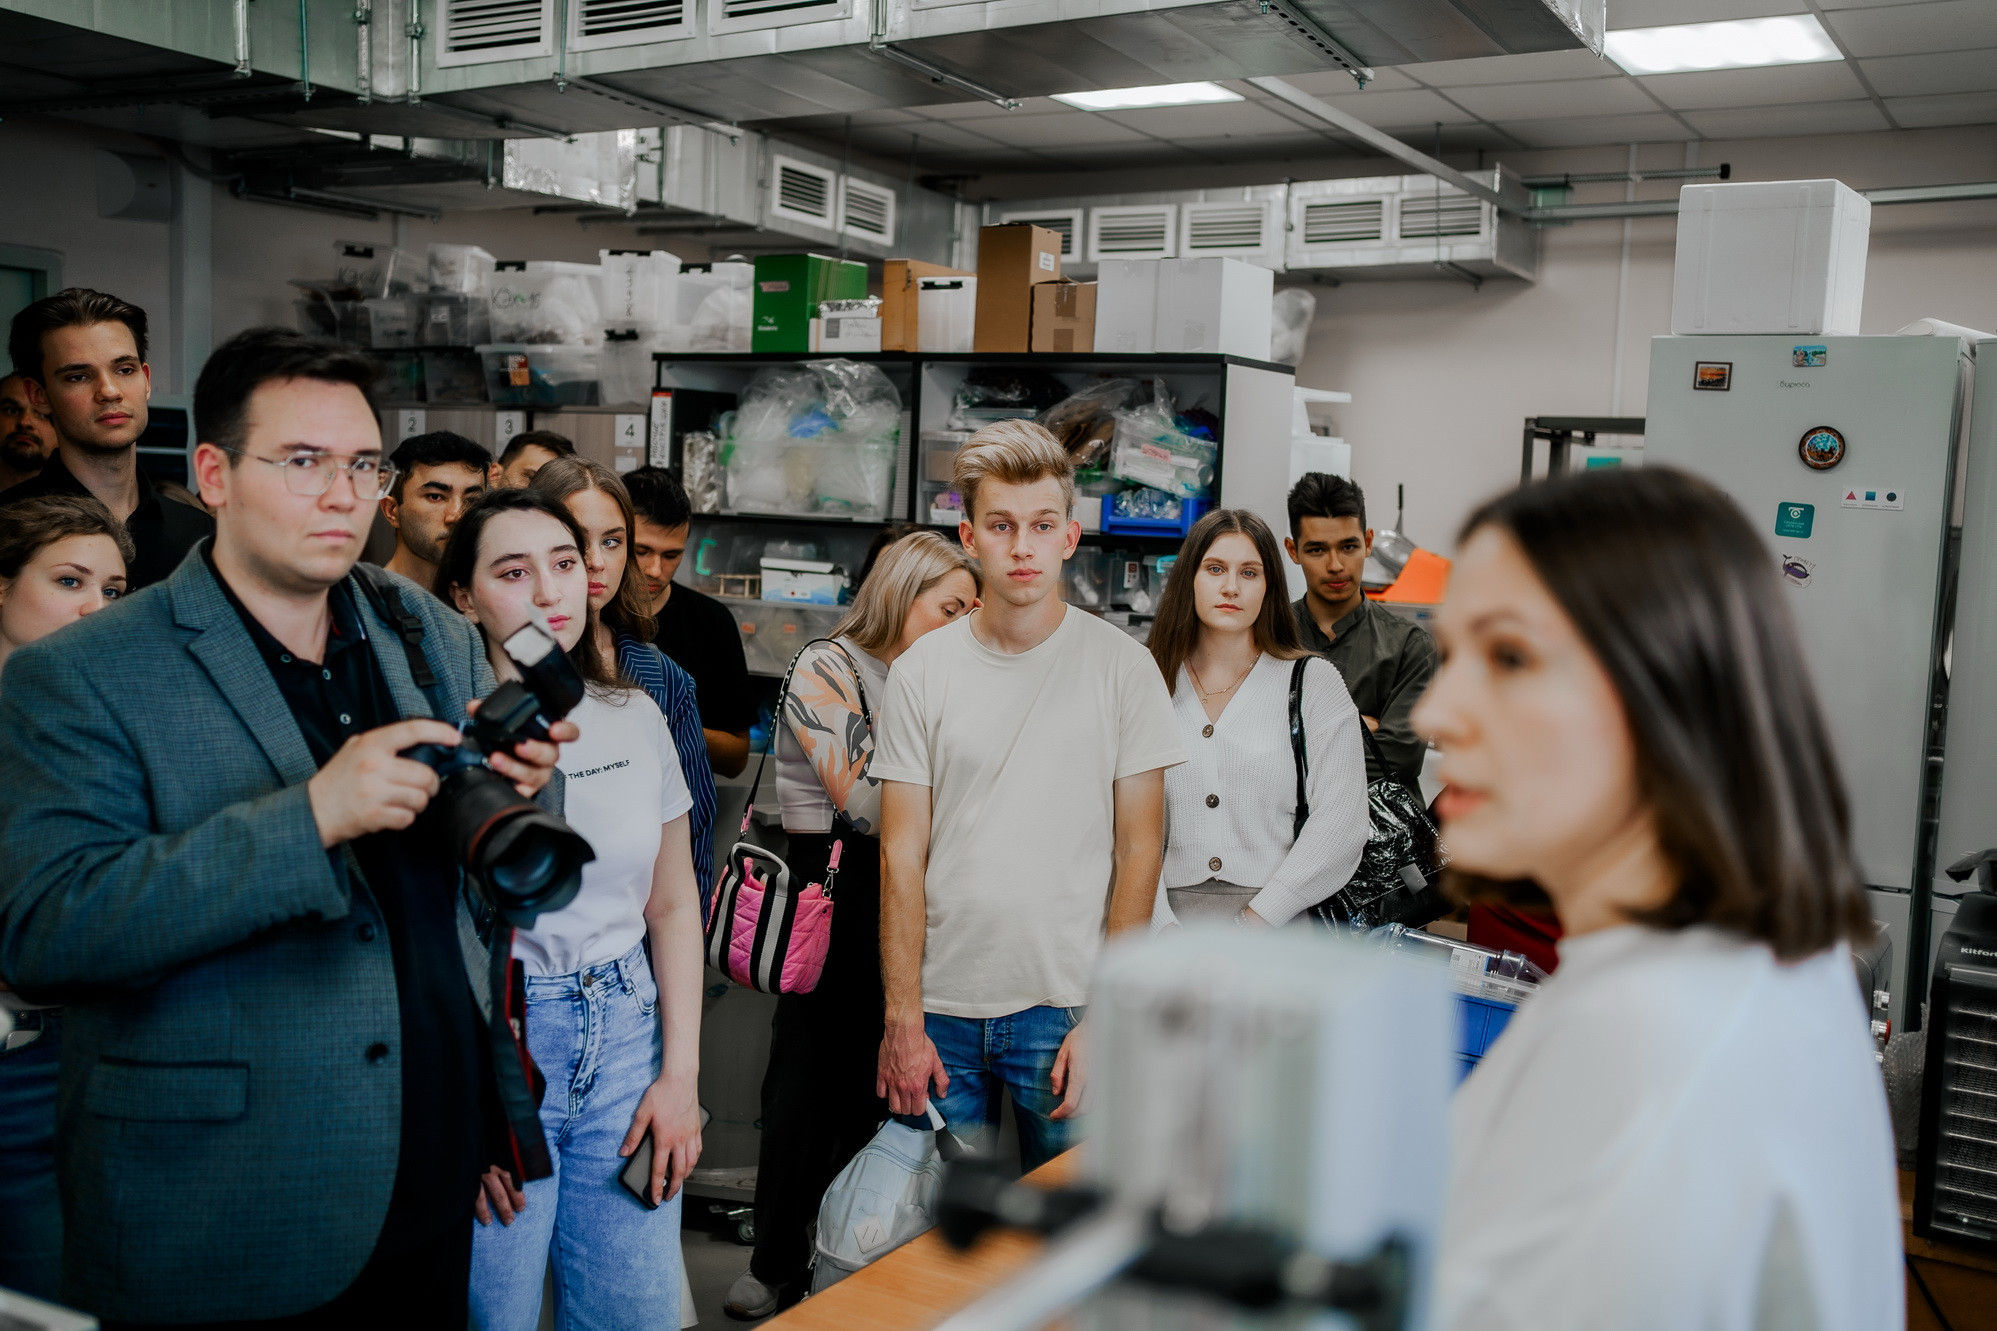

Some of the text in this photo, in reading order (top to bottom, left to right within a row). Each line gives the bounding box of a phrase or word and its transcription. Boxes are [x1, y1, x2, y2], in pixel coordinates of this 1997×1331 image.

[407, 416, 417, 433] 2
[504, 418, 514, 435] 3
[624, 423, 635, 437] 4
[567, 771, 585, 780] THE
[585, 767, 604, 777] DAY:
[603, 759, 630, 772] MYSELF
